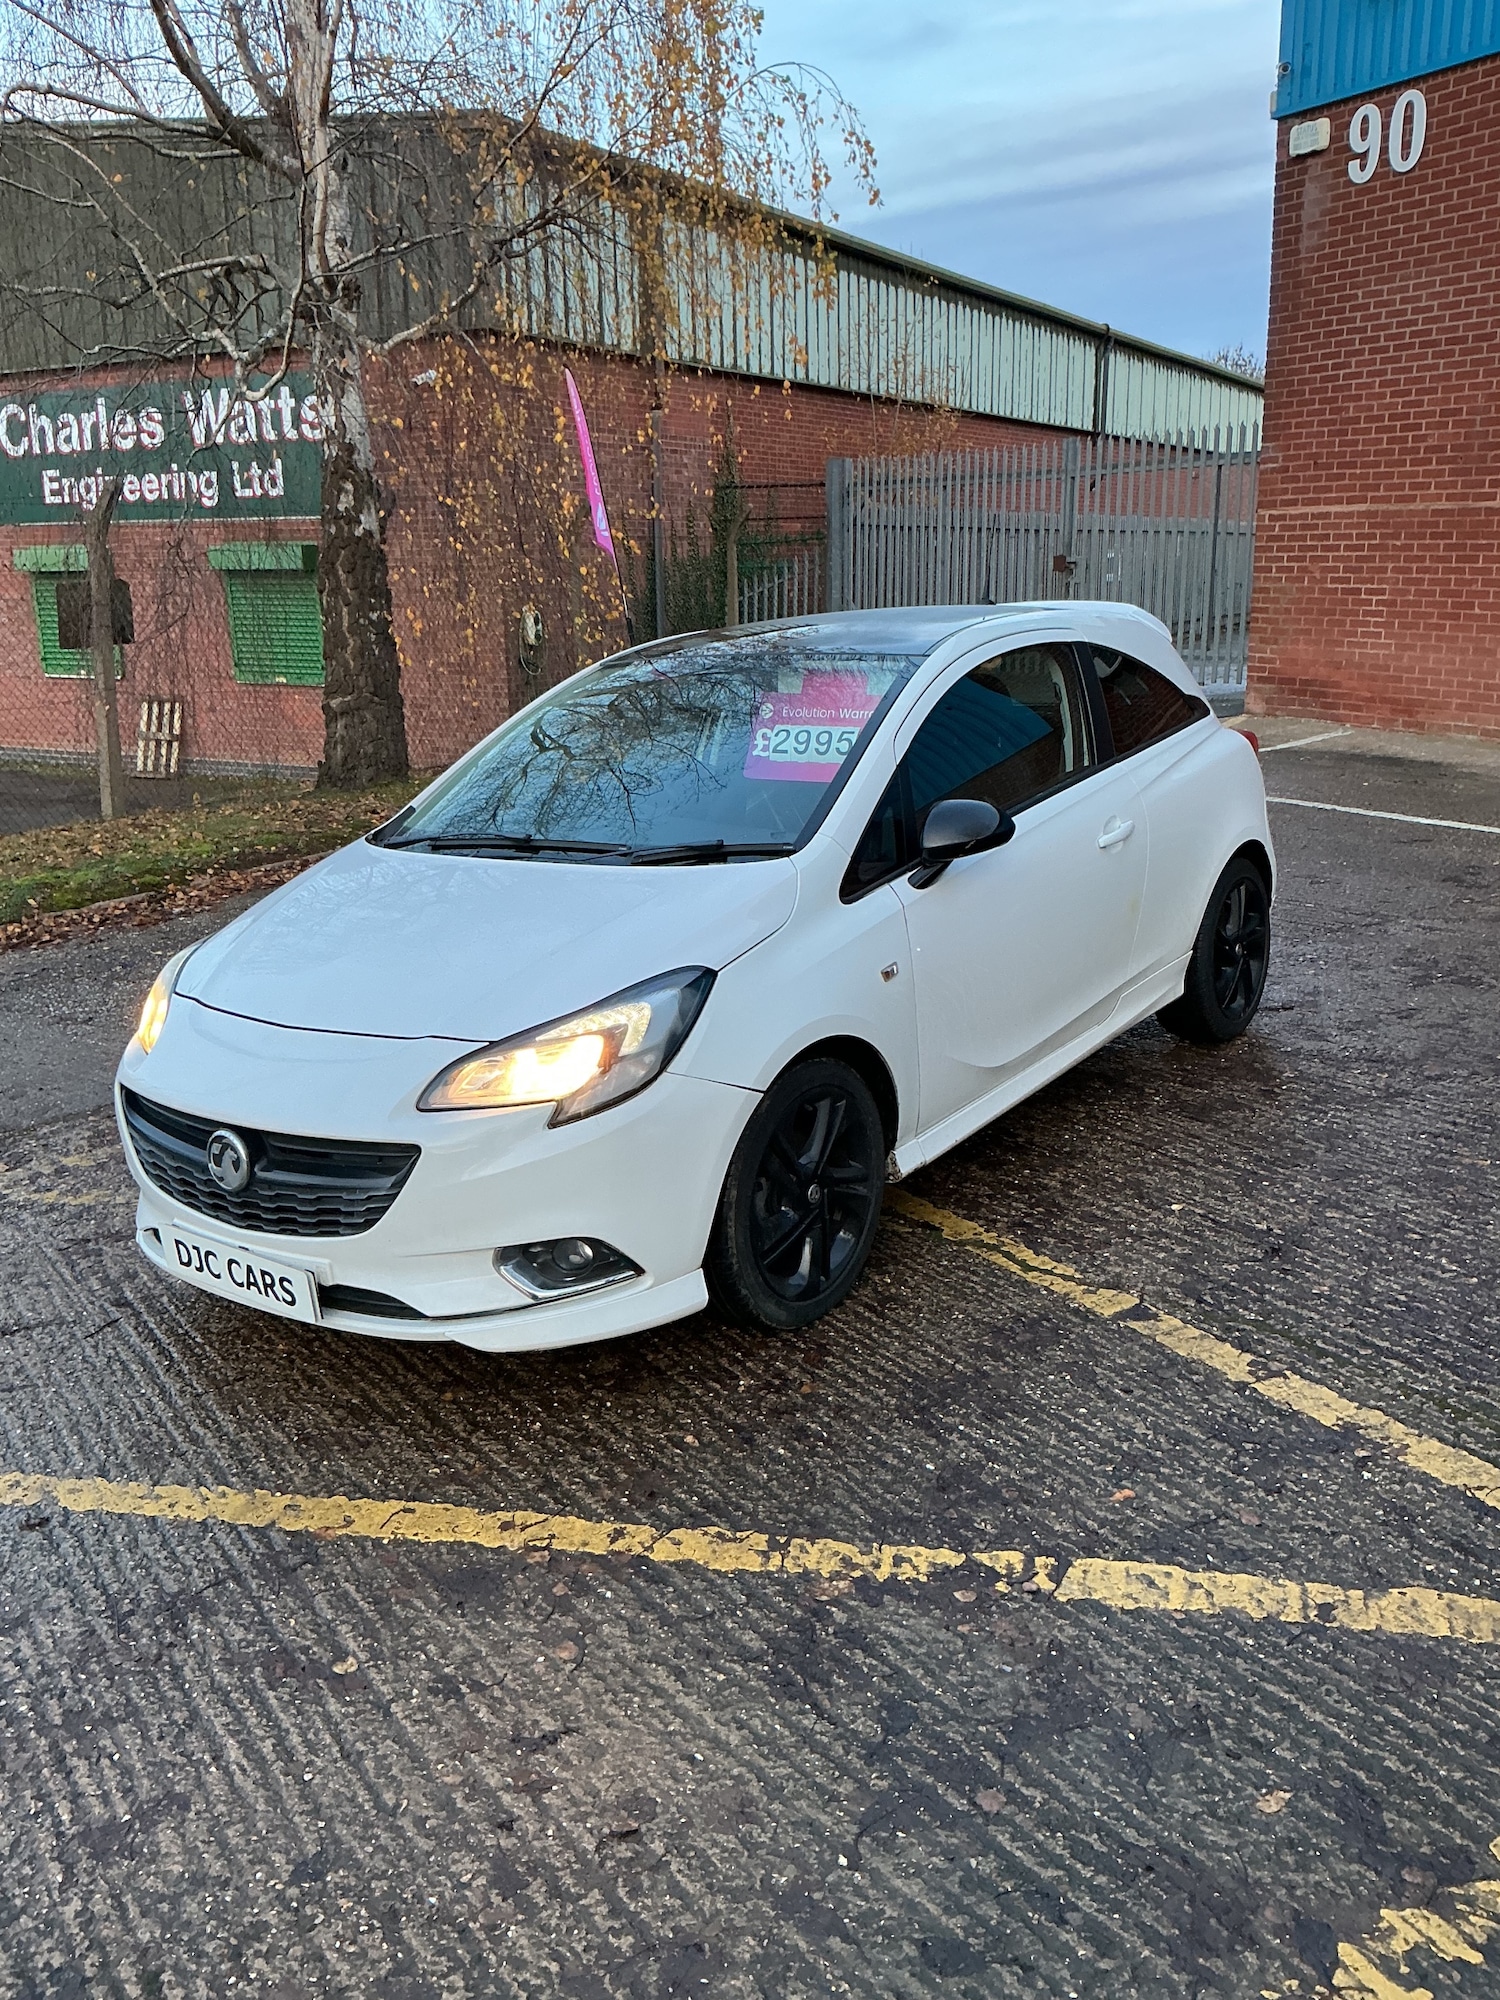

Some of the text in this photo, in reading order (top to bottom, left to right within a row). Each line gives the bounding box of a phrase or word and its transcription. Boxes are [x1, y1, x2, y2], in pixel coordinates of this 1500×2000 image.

[1348, 89, 1427, 183] 90
[0, 386, 326, 457] Charles Watts
[42, 458, 284, 509] Engieering Ltd
[752, 728, 855, 757] £2995
[782, 706, 835, 719] Evolution
[174, 1238, 297, 1307] DJC CARS
